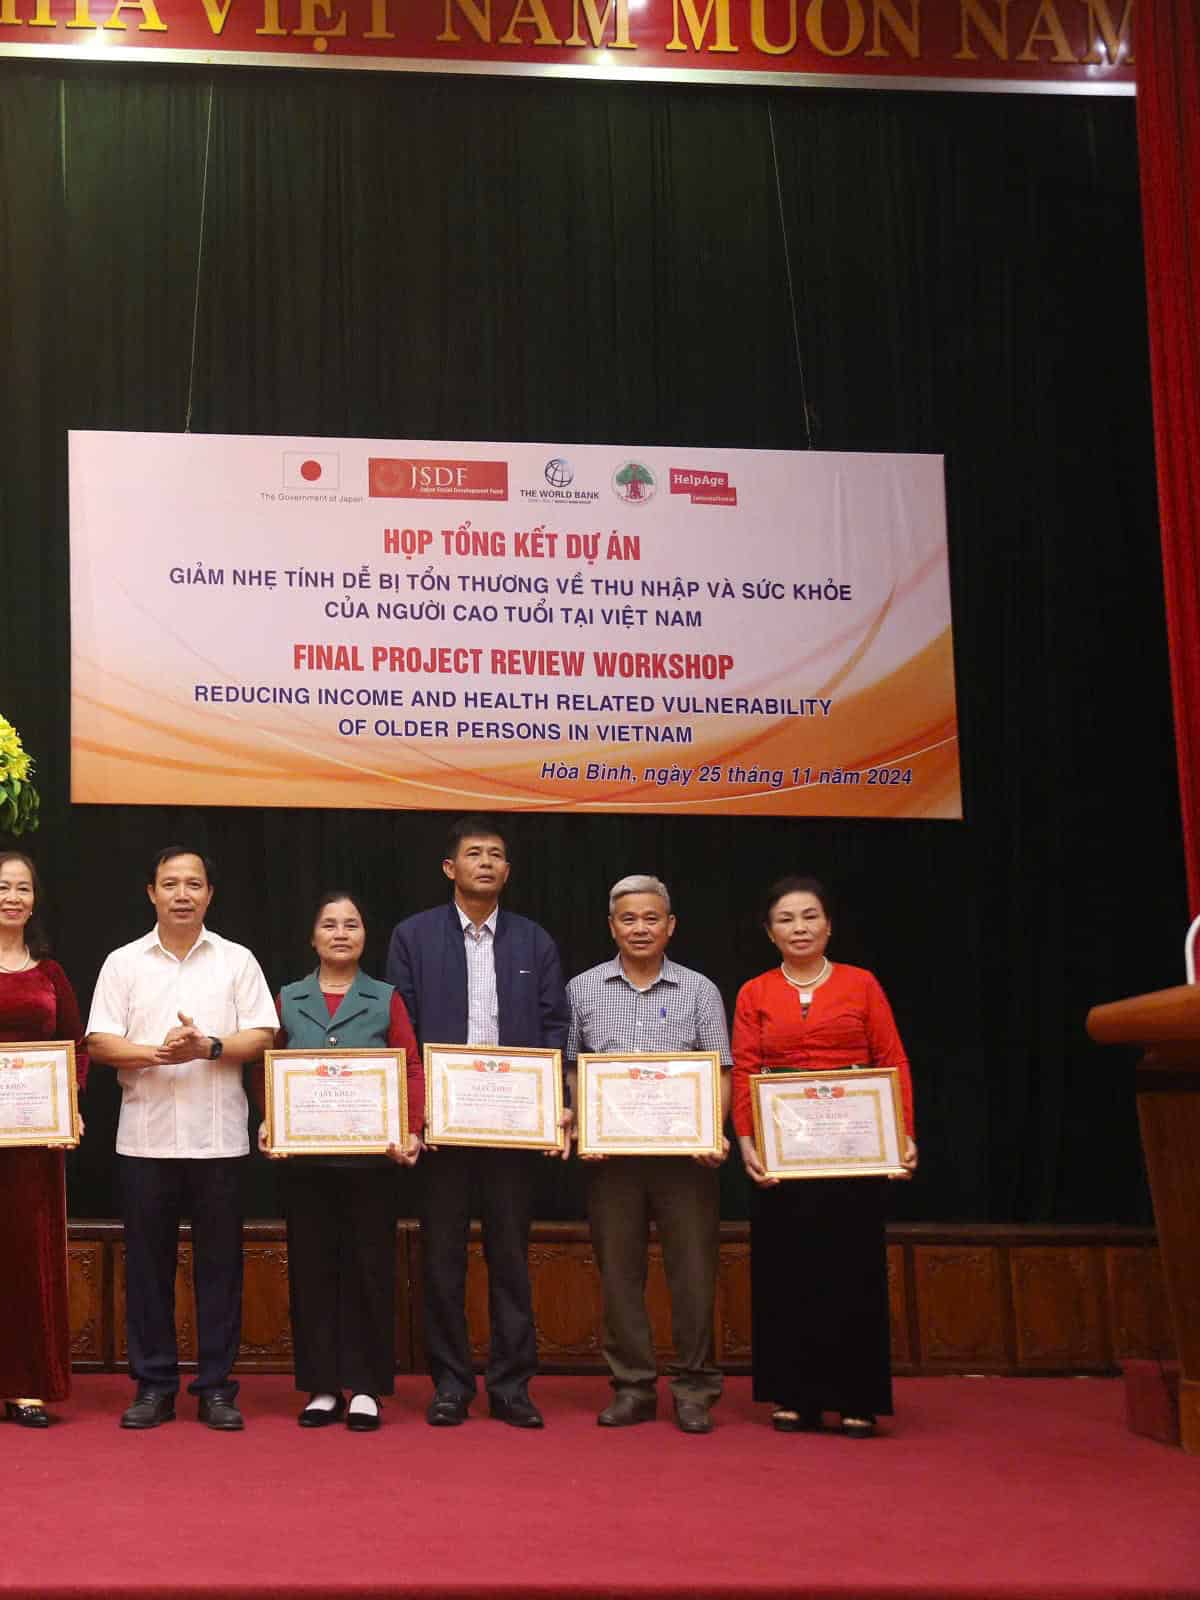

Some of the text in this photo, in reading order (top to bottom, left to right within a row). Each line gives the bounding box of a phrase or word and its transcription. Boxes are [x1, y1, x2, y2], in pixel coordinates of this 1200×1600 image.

[411, 465, 468, 489] JSDF
[674, 474, 725, 488] HelpAge
[520, 489, 600, 500] THE WORLD BANK
[384, 529, 433, 560] HỌP
[441, 521, 506, 557] TỔNG
[514, 525, 557, 559] KẾT
[566, 532, 601, 564] DỰ
[169, 562, 852, 601] GIẢM NHẸ TÍNH DỄ BỊ TỔN THƯƠNG VỀ THU NHẬP VÀ SỨC KHỎE
[324, 596, 702, 629] CỦA NGƯỜI CAO TUỔI TẠI VIỆT NAM
[294, 644, 734, 680] FINAL PROJECT REVIEW WORKSHOP
[195, 686, 832, 716] REDUCING INCOME AND HEALTH RELATED VULNERABILITY
[339, 719, 692, 743] OF OLDER PERSONS IN VIETNAM
[541, 763, 913, 785] Hòa Bình, ngày 25 tháng 11 năm 2024
